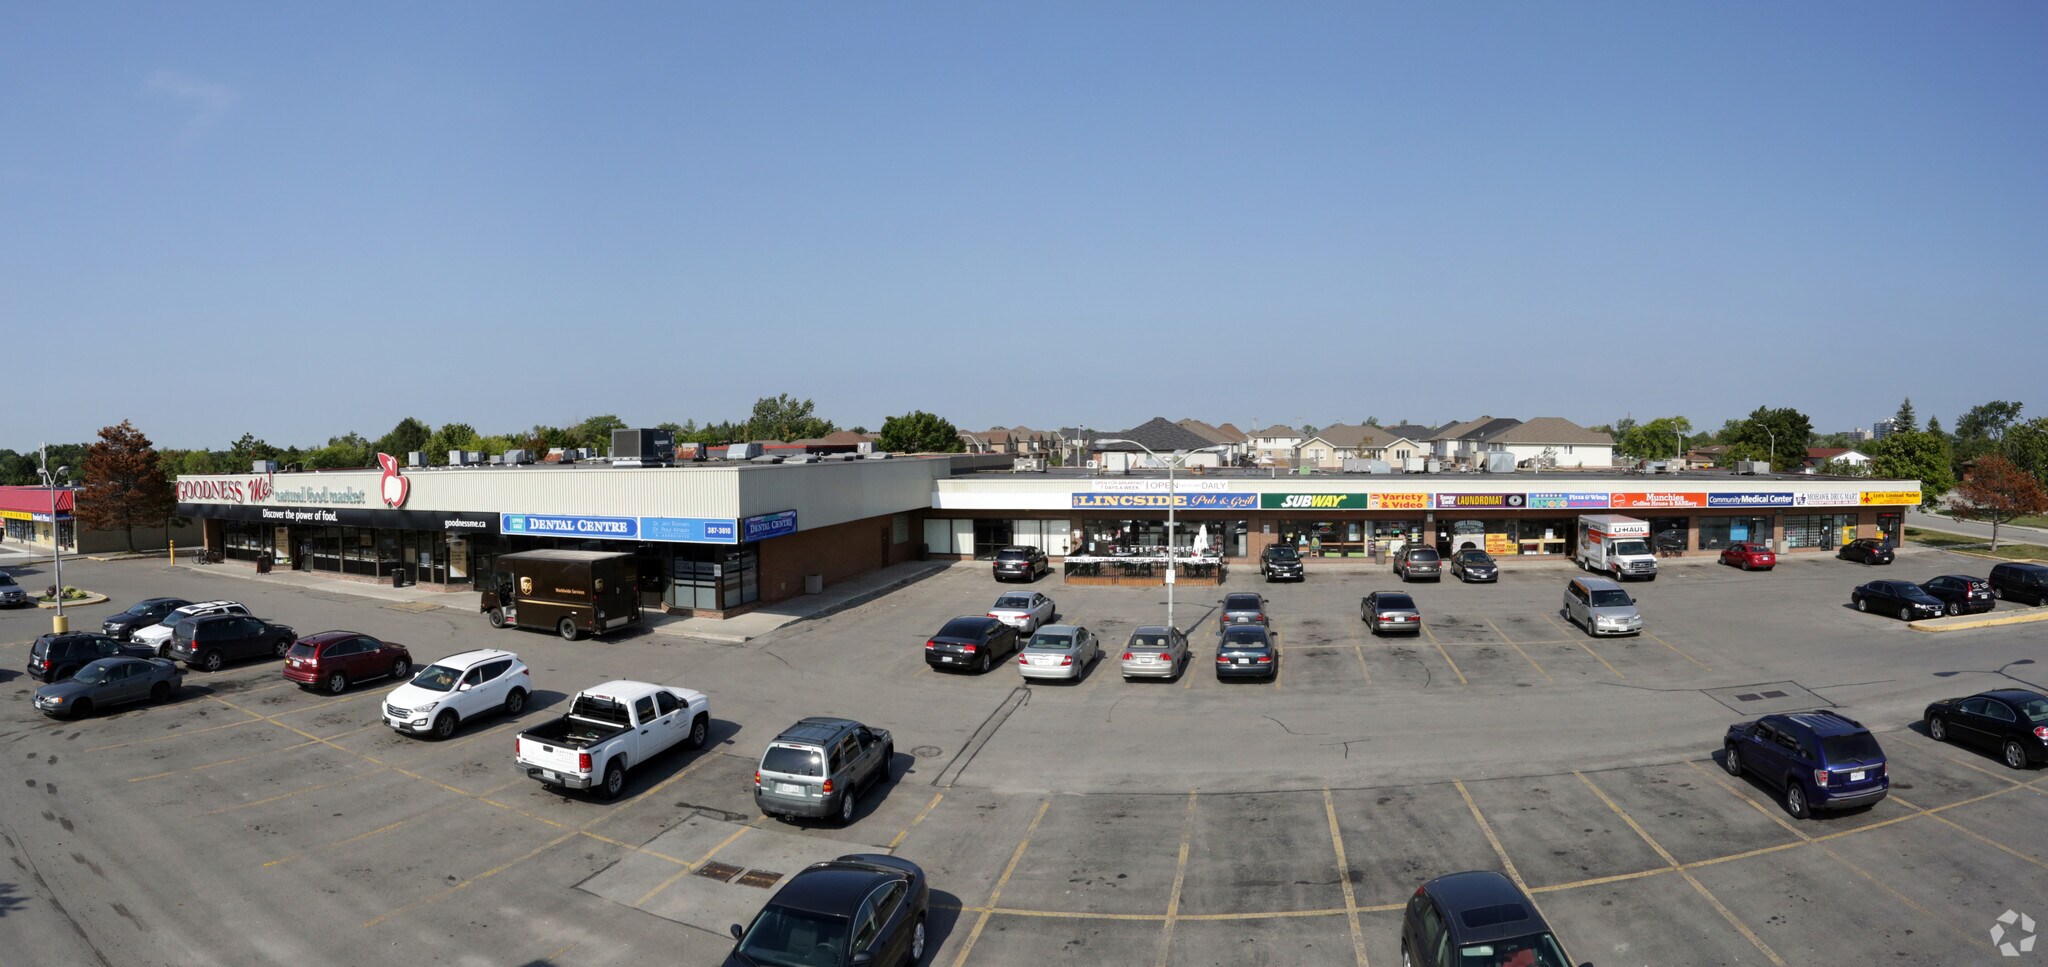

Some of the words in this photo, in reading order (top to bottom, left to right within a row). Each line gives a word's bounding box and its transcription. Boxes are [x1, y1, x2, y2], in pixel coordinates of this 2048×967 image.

[176, 480, 243, 504] GOODNESS
[248, 470, 273, 503] Me!
[1202, 482, 1226, 490] DAILY
[276, 489, 306, 503] natural
[307, 486, 329, 504] food
[1078, 496, 1188, 506] LINCSIDE
[1190, 495, 1217, 506] Pub
[1220, 497, 1228, 505] &
[1227, 496, 1256, 508] Grill
[1281, 494, 1348, 508] SUBWAY
[1458, 496, 1503, 506] LAUNDROMAT
[1709, 496, 1741, 504] Community
[1741, 494, 1768, 502] Medical
[262, 508, 284, 518] Discover
[285, 509, 295, 520] the
[296, 511, 314, 522] power
[314, 510, 322, 520] of
[322, 511, 338, 522] food.
[444, 518, 486, 528] goodnessme.ca
[529, 518, 575, 531] DENTAL
[577, 519, 628, 533] CENTRE
[750, 522, 770, 533] DENTAL
[771, 519, 793, 529] CENTRE
